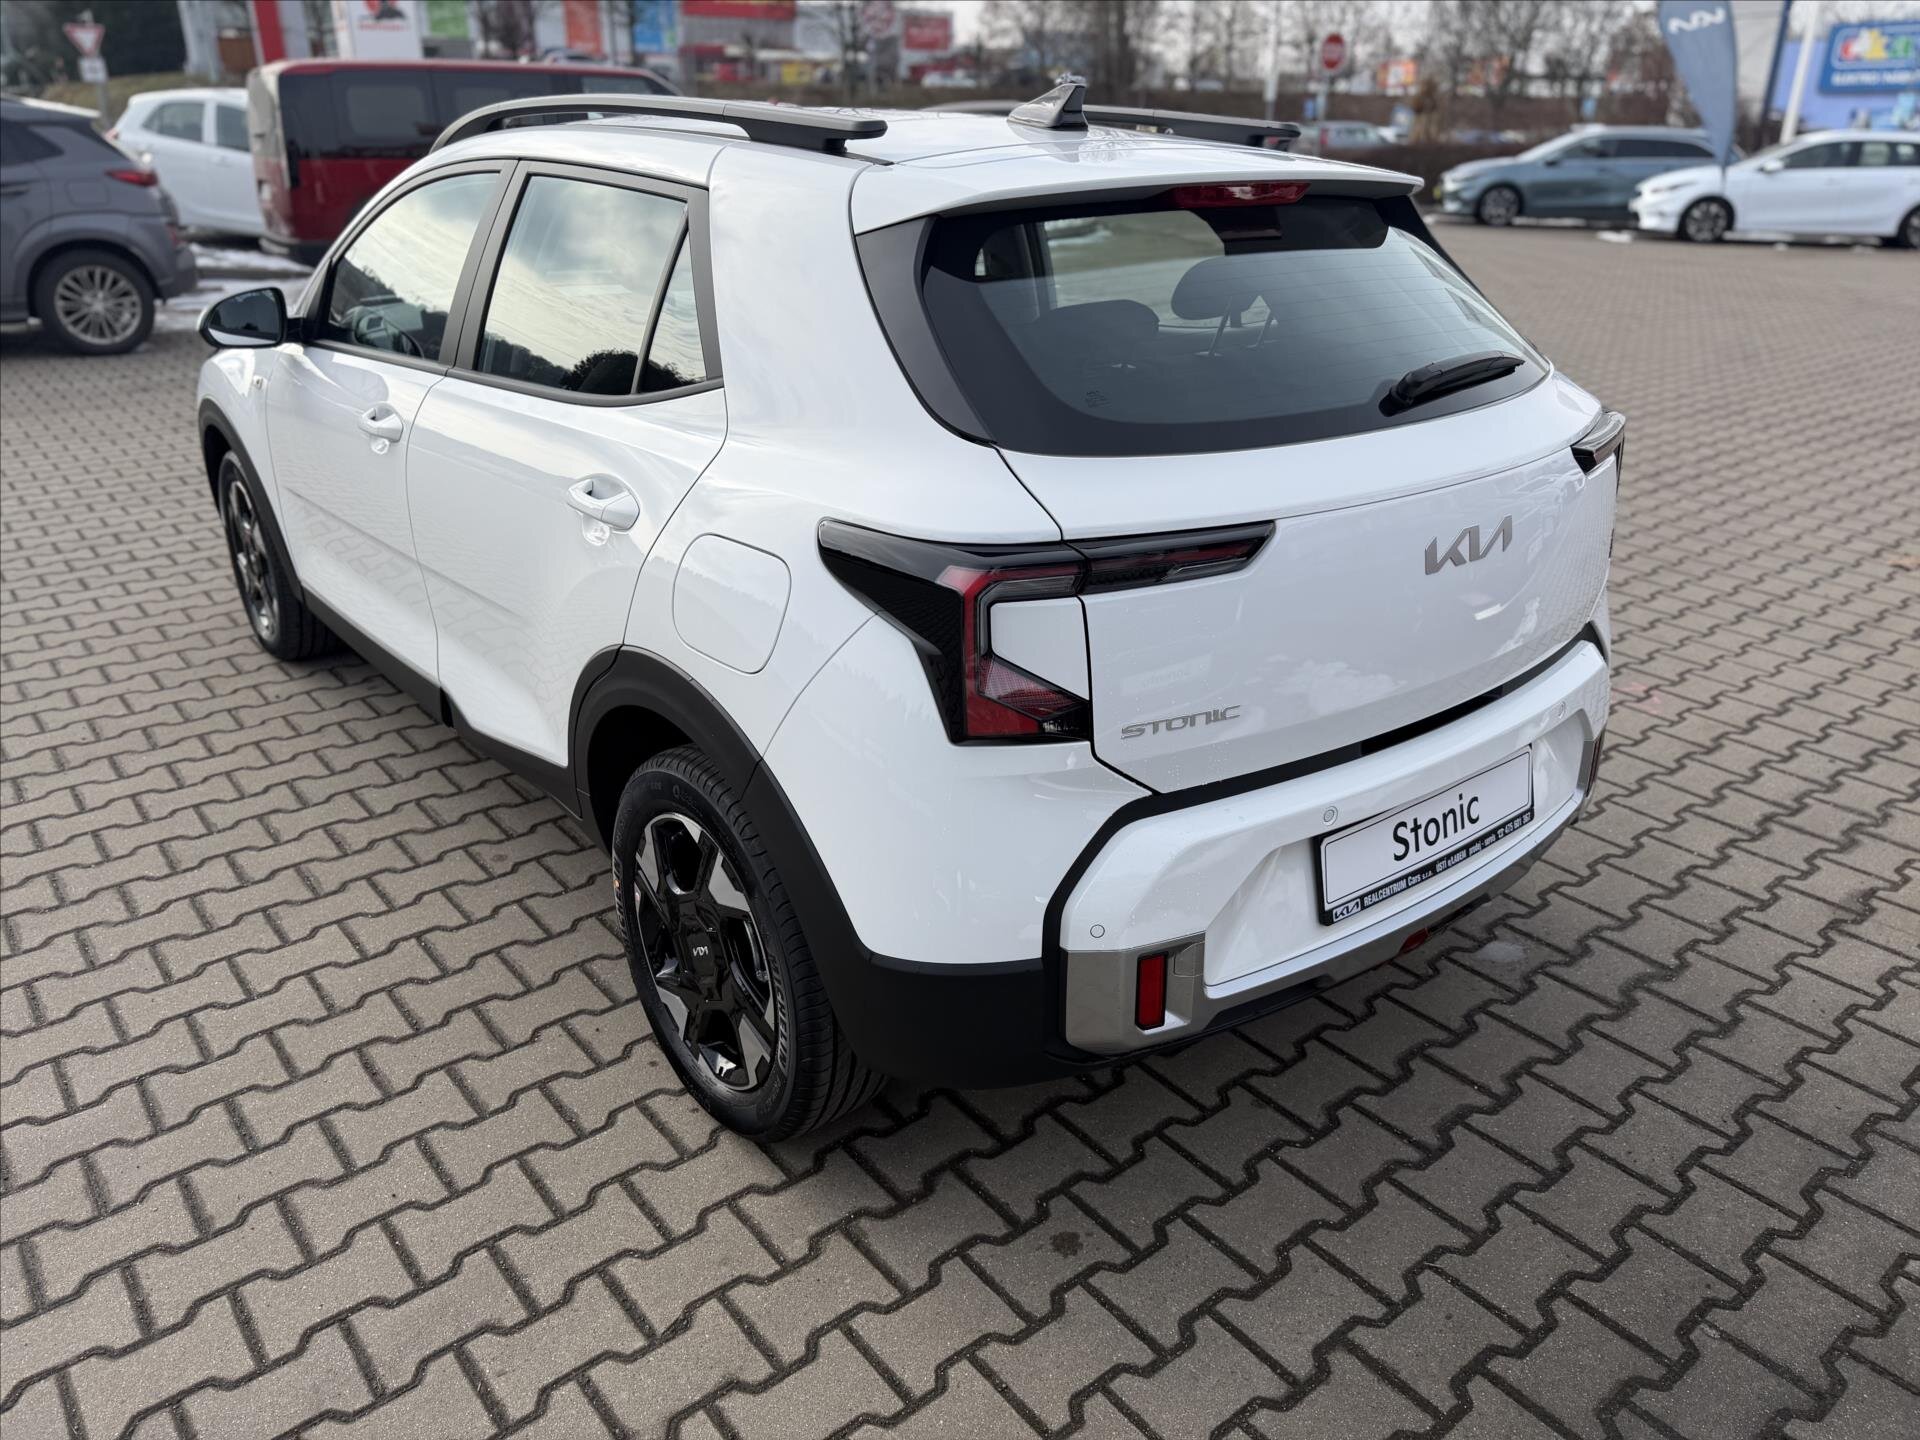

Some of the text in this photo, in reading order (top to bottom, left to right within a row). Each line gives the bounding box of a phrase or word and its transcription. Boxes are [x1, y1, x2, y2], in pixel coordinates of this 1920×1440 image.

[1424, 515, 1513, 575] KIA
[1121, 704, 1241, 740] STONIC
[1392, 793, 1480, 862] Stonic
[1363, 878, 1407, 907] REALCENTRUM
[1408, 873, 1421, 886] Cars
